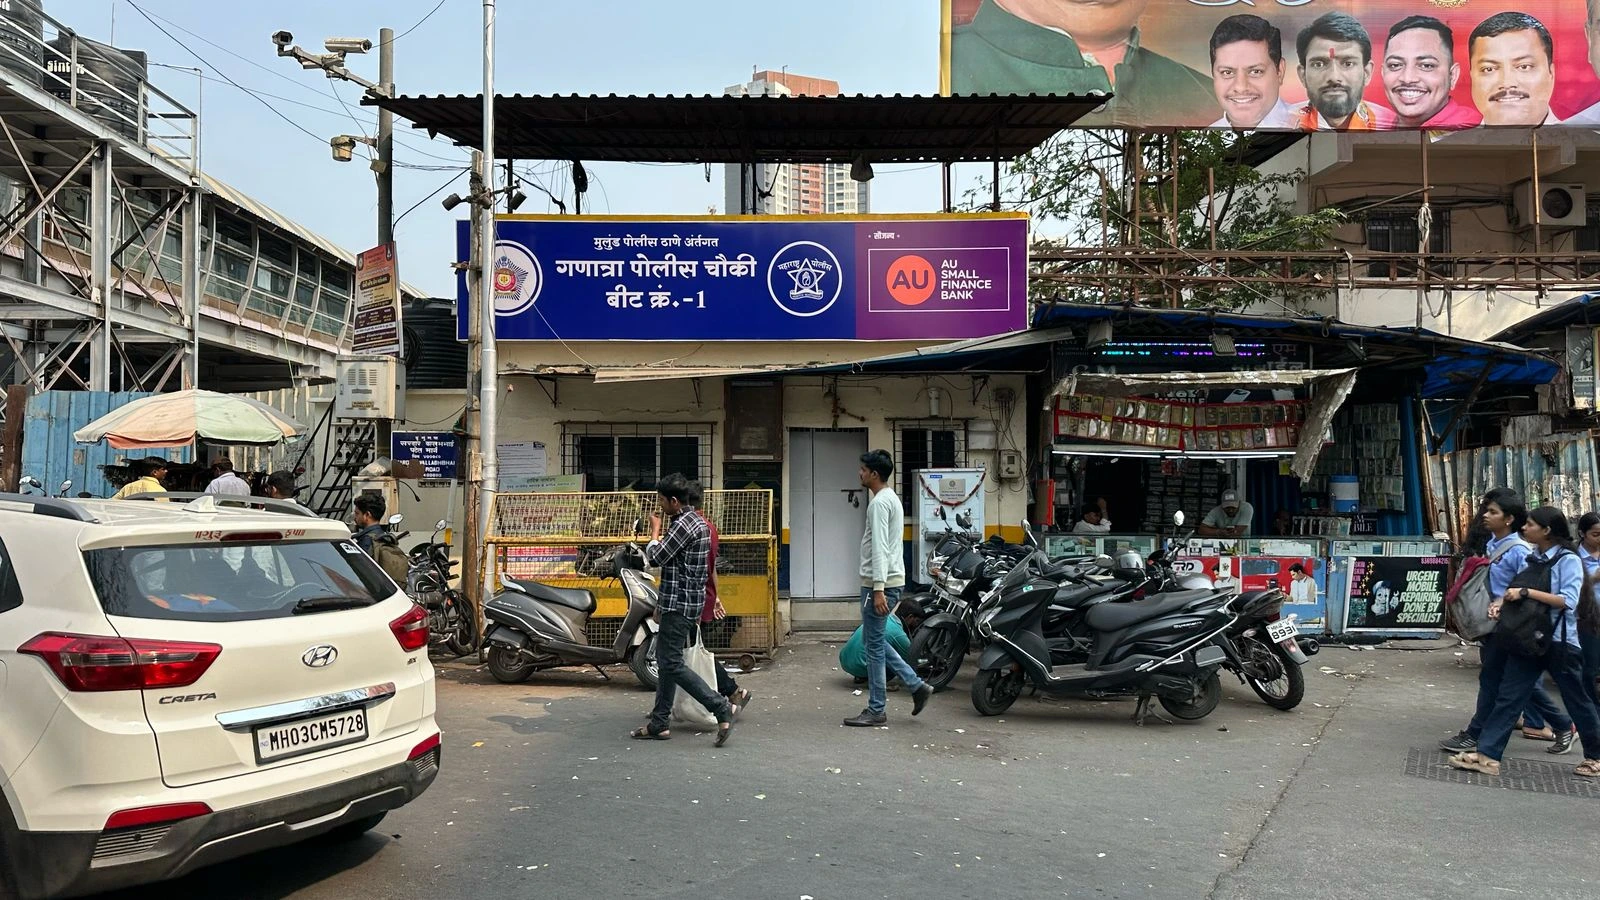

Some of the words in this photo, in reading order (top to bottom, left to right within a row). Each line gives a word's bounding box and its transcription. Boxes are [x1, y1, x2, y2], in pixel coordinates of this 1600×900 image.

[593, 234, 620, 250] मुलुंड
[623, 233, 658, 247] पोलीस
[660, 234, 681, 247] ठाणे
[555, 260, 625, 278] गणात्रा
[629, 253, 698, 279] पोलीस
[703, 253, 757, 278] चौकी
[777, 259, 800, 270] महाराष्ट्र
[810, 257, 833, 271] पोलीस
[940, 259, 958, 269] AU
[892, 269, 930, 290] AU
[940, 269, 980, 279] SMALL
[940, 279, 992, 290] FINANCE
[606, 284, 644, 308] बीट
[940, 290, 974, 300] BANK
[1406, 570, 1440, 582] URGENT
[1406, 581, 1438, 592] MOBILE
[1399, 591, 1443, 603] REPAIRING
[1403, 602, 1427, 613] DONE
[1427, 602, 1439, 613] BY
[1396, 613, 1442, 623] SPECIALIST
[1271, 625, 1296, 640] 8931
[158, 692, 217, 705] CRETA
[269, 714, 364, 751] MH03CM5728
